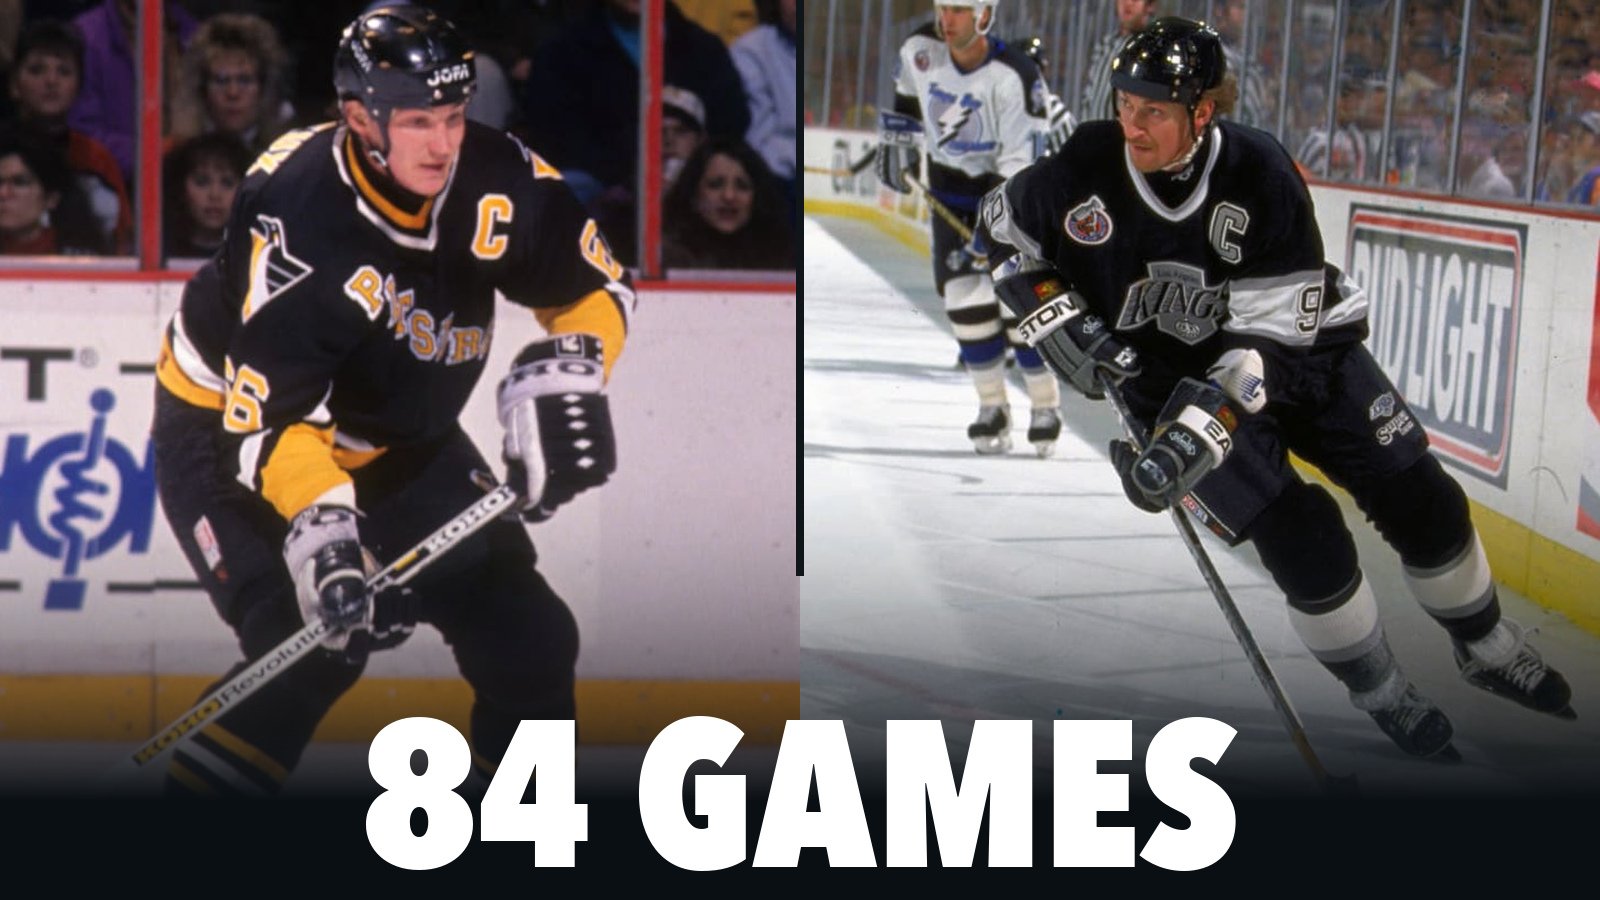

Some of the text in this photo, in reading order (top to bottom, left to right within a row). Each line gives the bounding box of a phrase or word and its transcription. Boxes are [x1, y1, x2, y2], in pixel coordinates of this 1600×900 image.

[427, 63, 470, 87] JOFA
[472, 194, 513, 260] C
[1209, 201, 1250, 264] C
[1295, 284, 1324, 336] 9
[132, 697, 222, 766] KOHO
